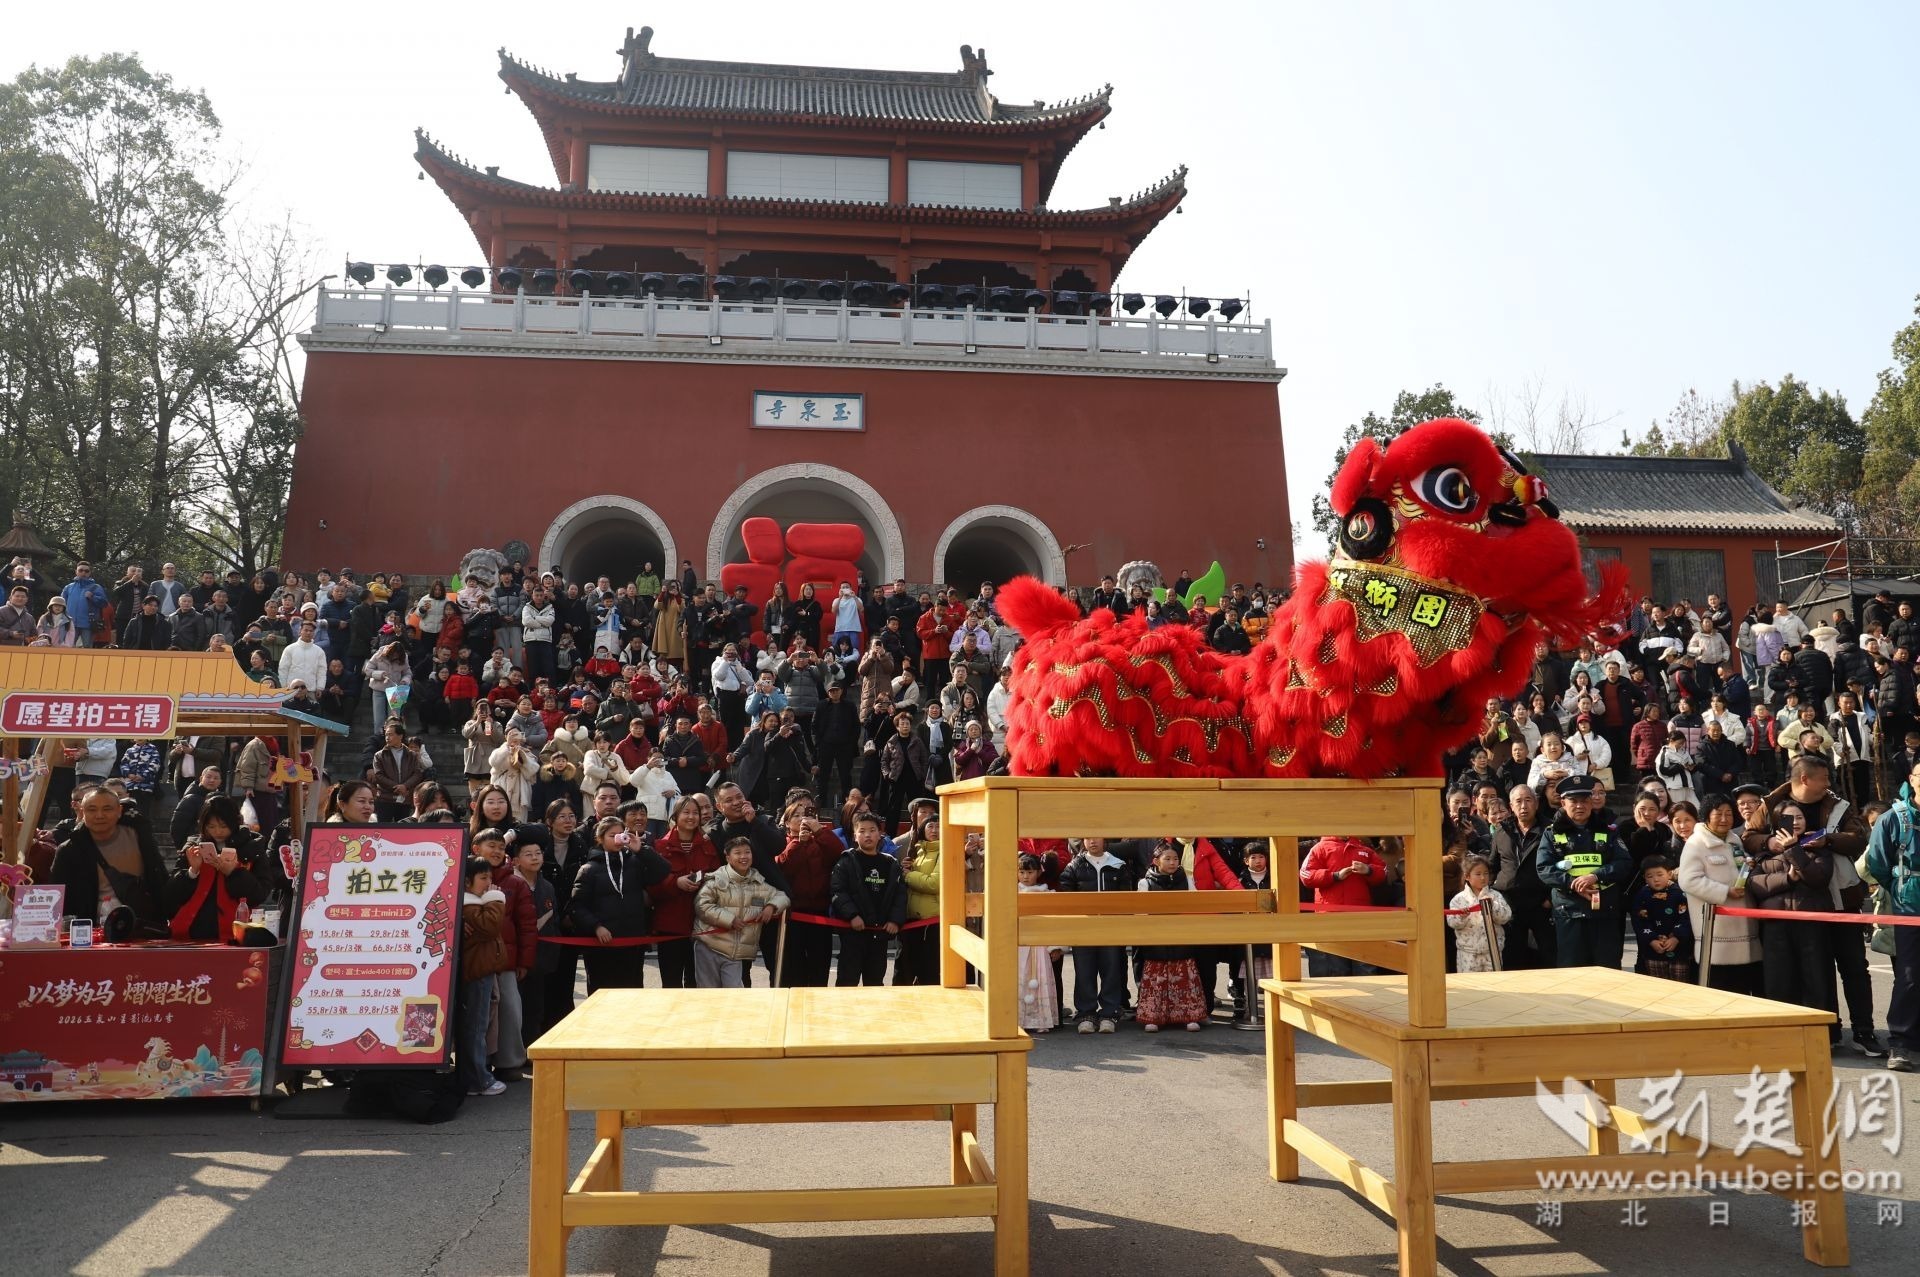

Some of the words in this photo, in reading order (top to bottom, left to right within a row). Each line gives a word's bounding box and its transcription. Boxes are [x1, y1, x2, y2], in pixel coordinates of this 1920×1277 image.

[16, 701, 161, 728] 愿望拍立得
[312, 839, 377, 863] 2026
[347, 867, 426, 894] 拍立得
[28, 979, 115, 1007] 以梦为马
[123, 977, 212, 1006] 熠熠生花
